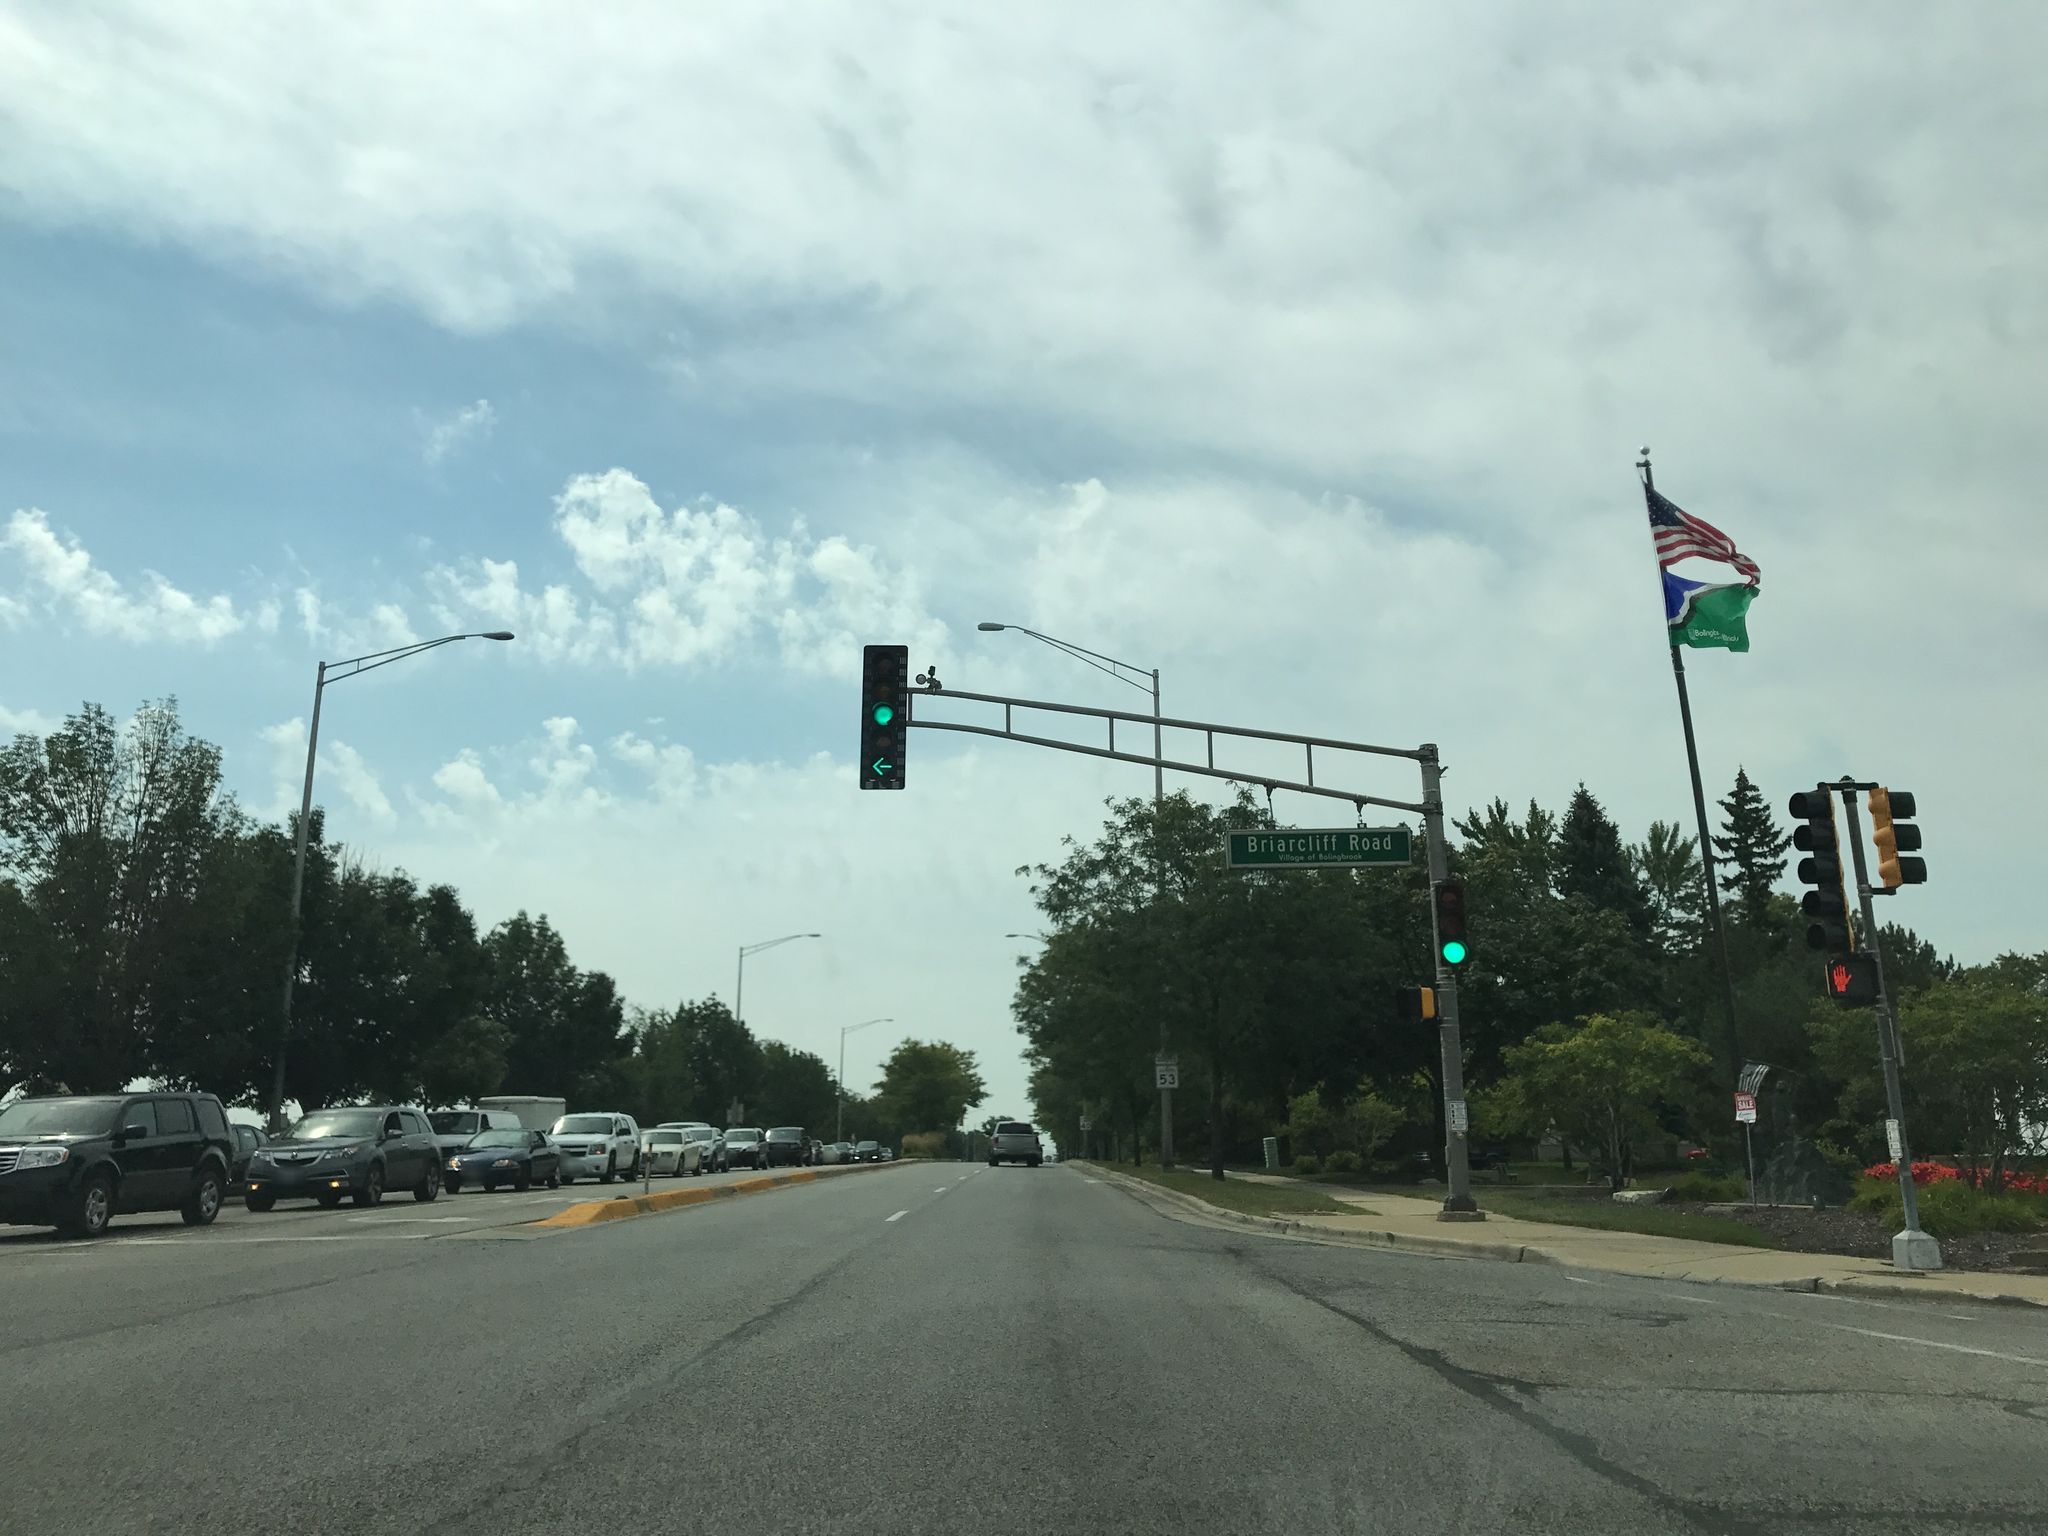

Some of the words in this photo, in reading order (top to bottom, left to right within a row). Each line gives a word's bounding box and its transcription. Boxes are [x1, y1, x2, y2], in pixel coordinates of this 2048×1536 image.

[1247, 835, 1338, 853] Briarcliff
[1349, 834, 1392, 850] Road
[1278, 854, 1304, 863] Village
[1319, 853, 1362, 861] Bolingbrook
[1160, 1074, 1175, 1085] 53
[1738, 1100, 1754, 1110] SALE
